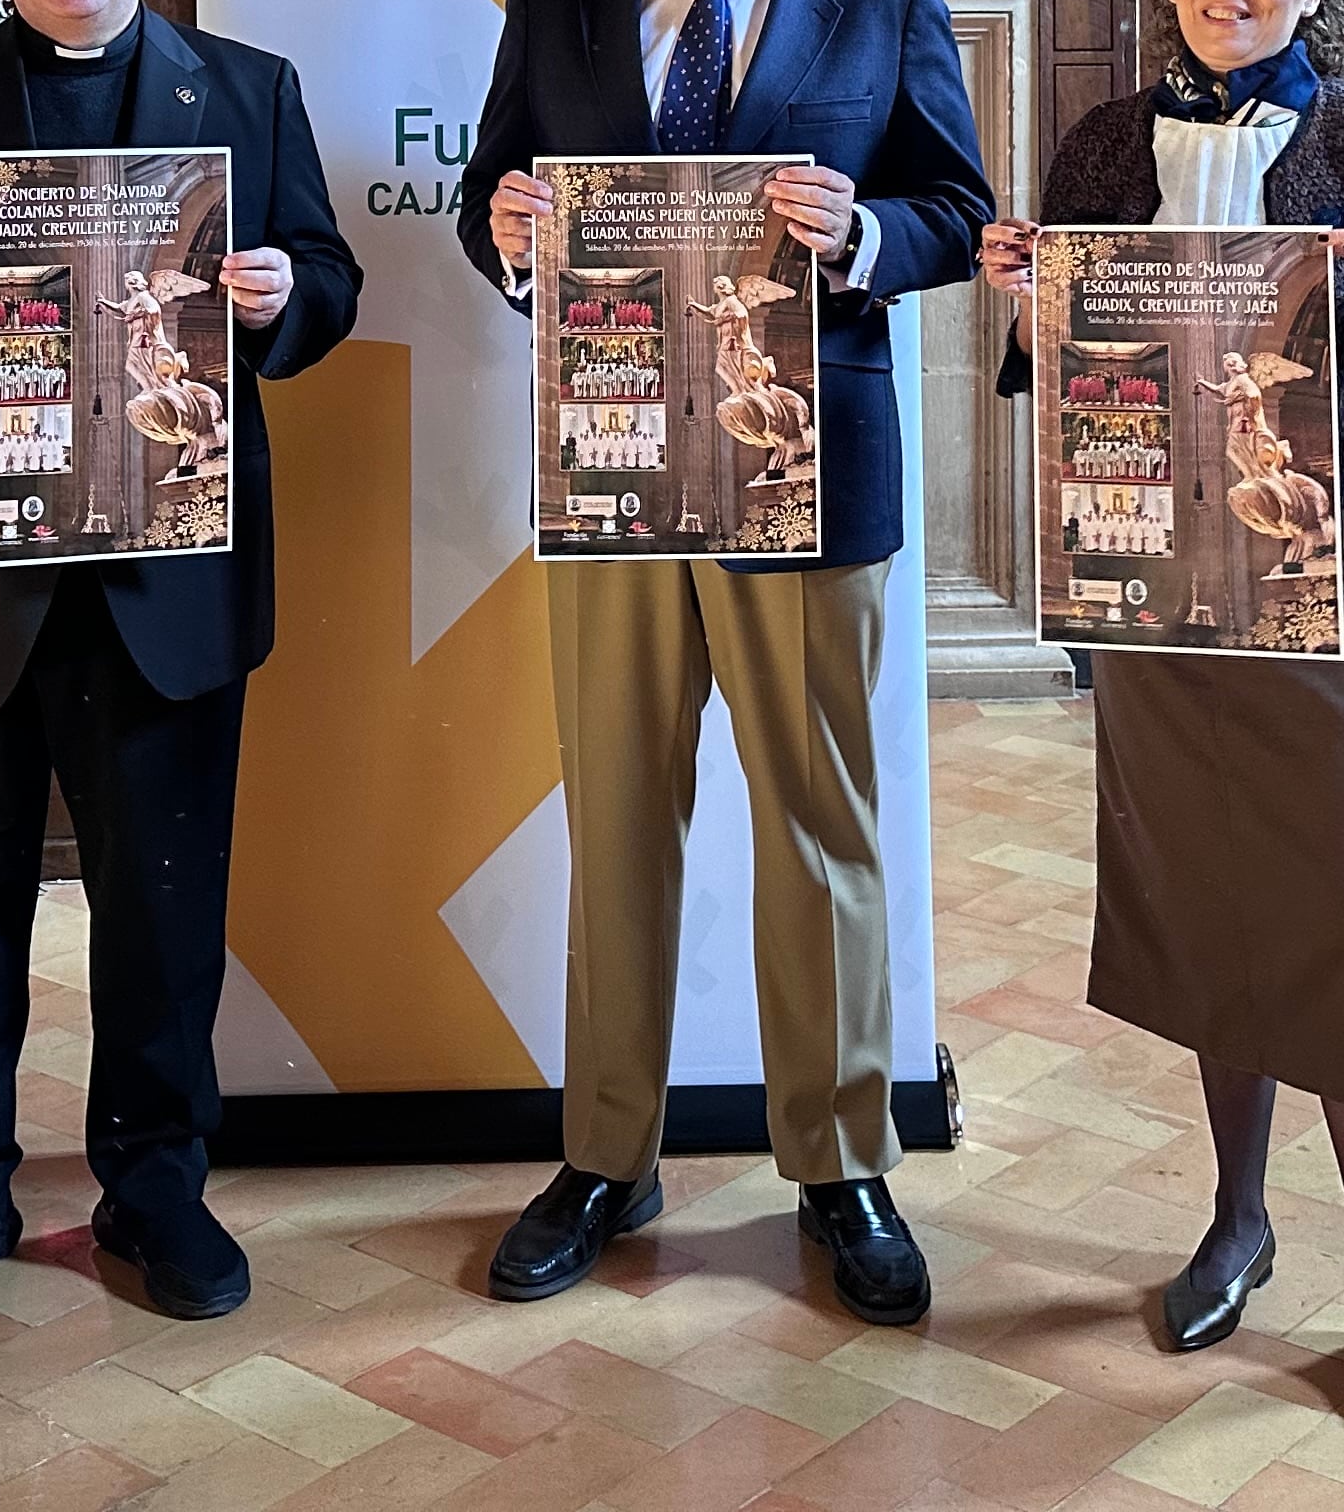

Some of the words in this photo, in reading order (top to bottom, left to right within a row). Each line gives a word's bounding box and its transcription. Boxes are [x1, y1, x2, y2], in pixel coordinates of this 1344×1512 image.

[80, 187, 97, 200] DE
[102, 184, 167, 201] NAVIDAD
[592, 190, 666, 208] CONCIERTO
[670, 191, 686, 205] DE
[691, 189, 752, 207] NAVIDAD
[68, 204, 107, 218] PUERI
[112, 202, 180, 216] CANTORES
[580, 207, 655, 223] ESCOLANÍAS
[660, 209, 696, 222] PUERI
[700, 208, 765, 222] CANTORES
[42, 221, 127, 236] CREVILLENTE
[132, 221, 141, 233] Y
[146, 216, 179, 233] JAÉN
[581, 226, 631, 241] GUADIX,
[635, 226, 715, 240] CREVILLENTE
[719, 226, 728, 239] Y
[733, 223, 764, 239] JAÉN
[1095, 260, 1172, 279] CONCIERTO
[1176, 263, 1194, 276] DE
[1198, 262, 1265, 279] NAVIDAD
[1082, 278, 1161, 294] ESCOLANÍAS
[1165, 281, 1204, 295] PUERI
[1208, 281, 1278, 296] CANTORES
[1083, 298, 1135, 313] GUADIX,
[1139, 299, 1224, 314] CREVILLENTE
[1229, 300, 1238, 314] Y
[1244, 298, 1278, 314] JAÉN
